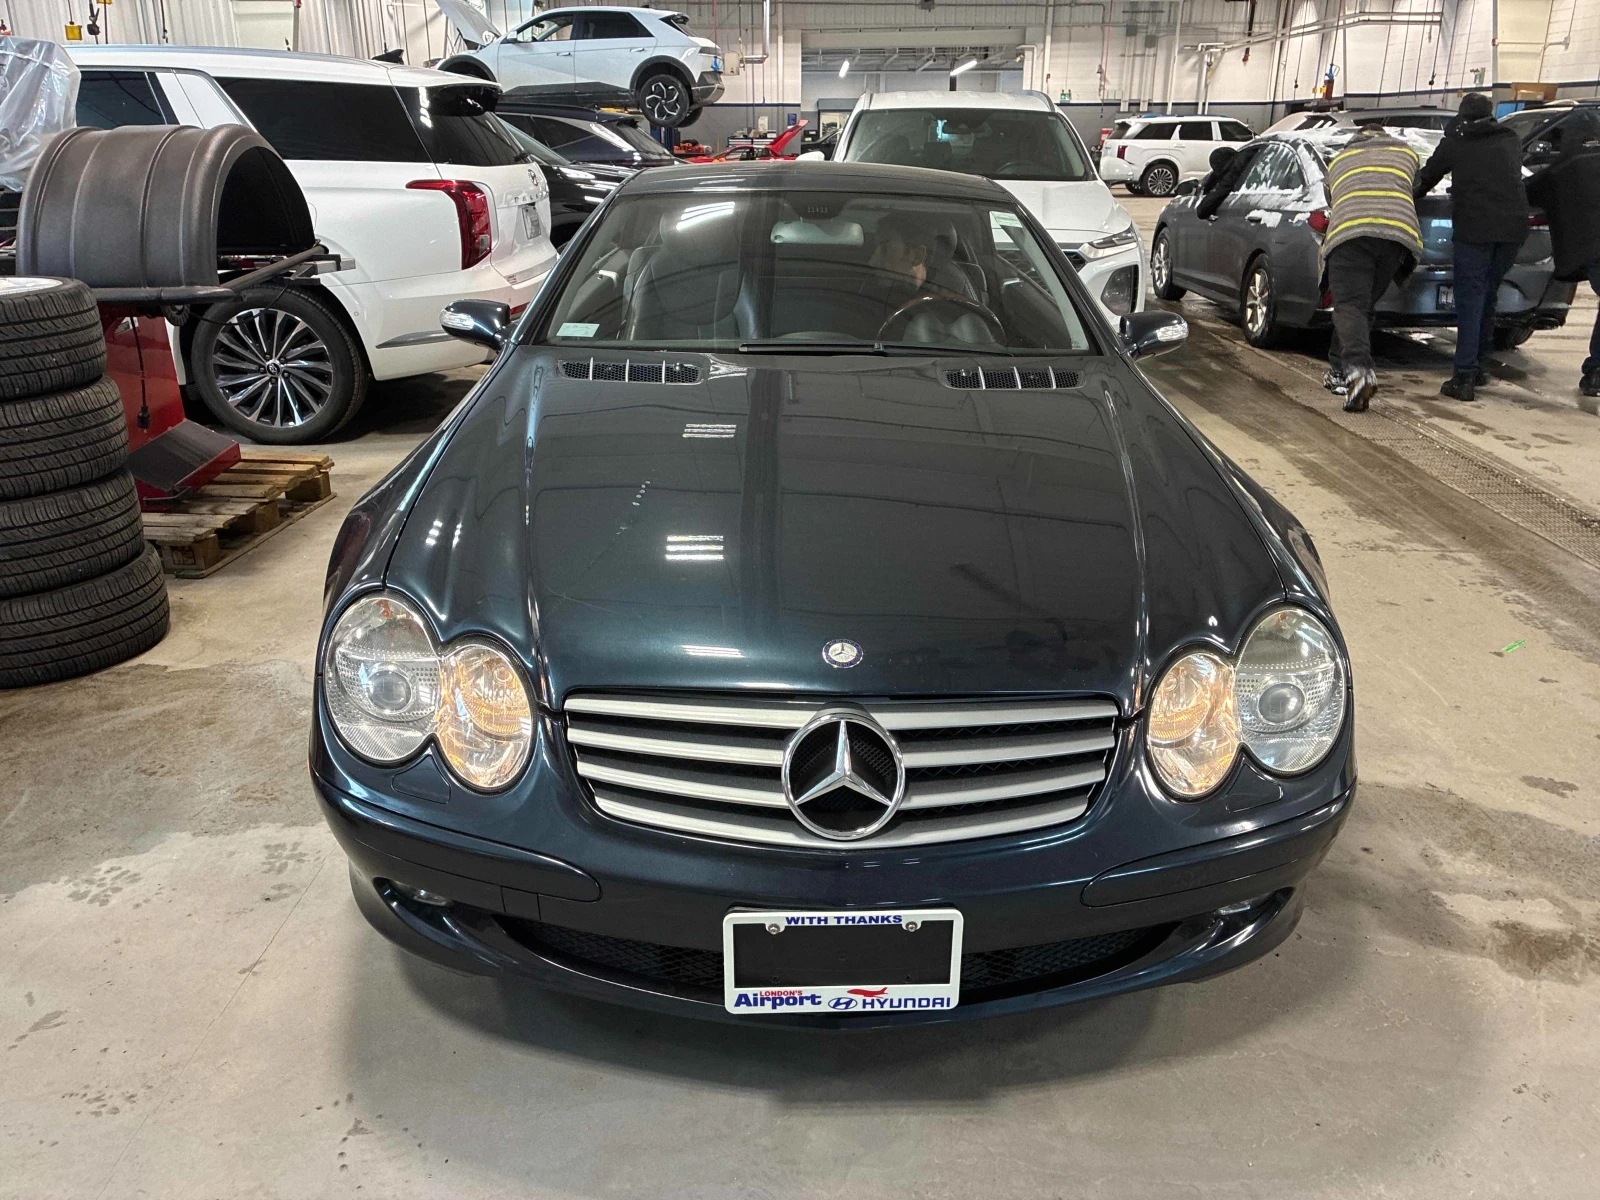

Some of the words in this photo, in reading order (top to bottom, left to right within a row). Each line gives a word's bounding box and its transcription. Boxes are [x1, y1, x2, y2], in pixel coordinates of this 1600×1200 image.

[785, 916, 829, 925] WITH
[834, 915, 902, 925] THANKS
[734, 993, 822, 1010] Airport
[862, 997, 951, 1009] HYUNDAI
